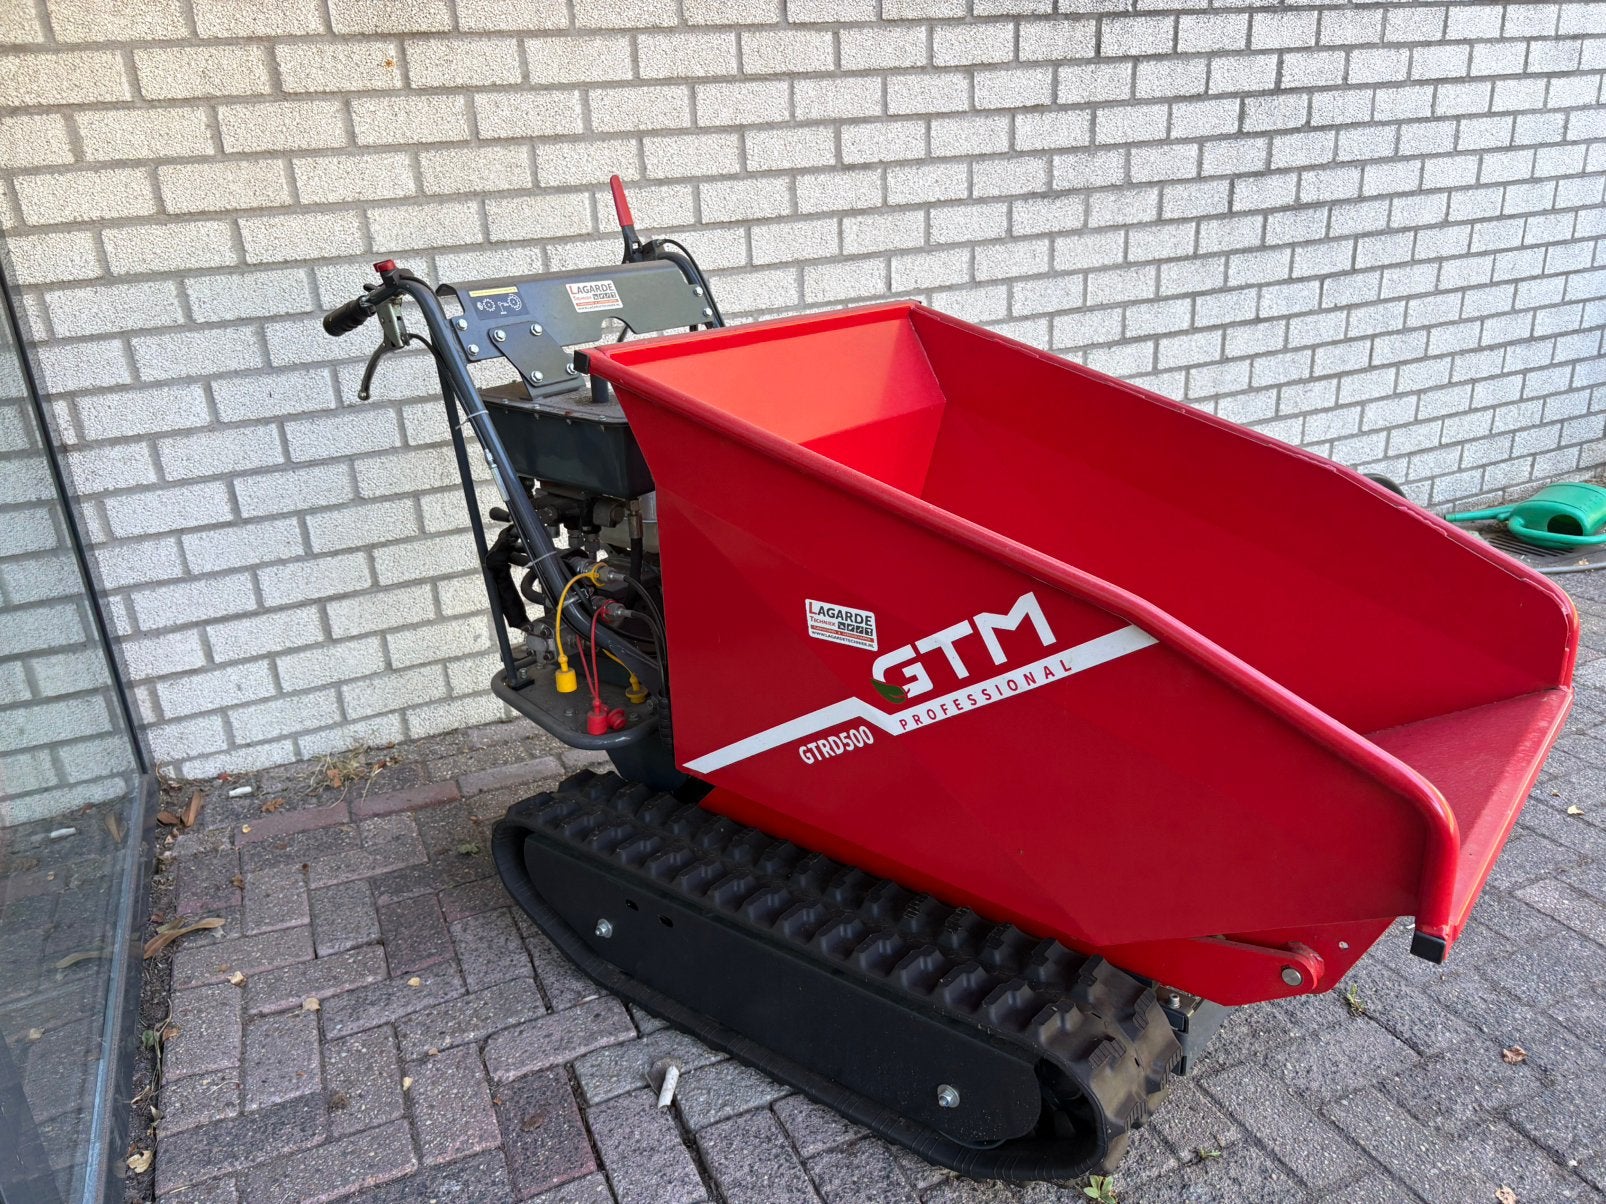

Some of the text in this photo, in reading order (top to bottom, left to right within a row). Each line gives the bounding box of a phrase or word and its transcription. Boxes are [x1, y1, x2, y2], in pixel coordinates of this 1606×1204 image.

[569, 283, 614, 295] LAGARDE
[809, 601, 873, 627] LAGARDE
[871, 591, 1057, 699] GTM
[899, 658, 1072, 731] PROFESSIONAL
[799, 725, 874, 764] GTRD500
